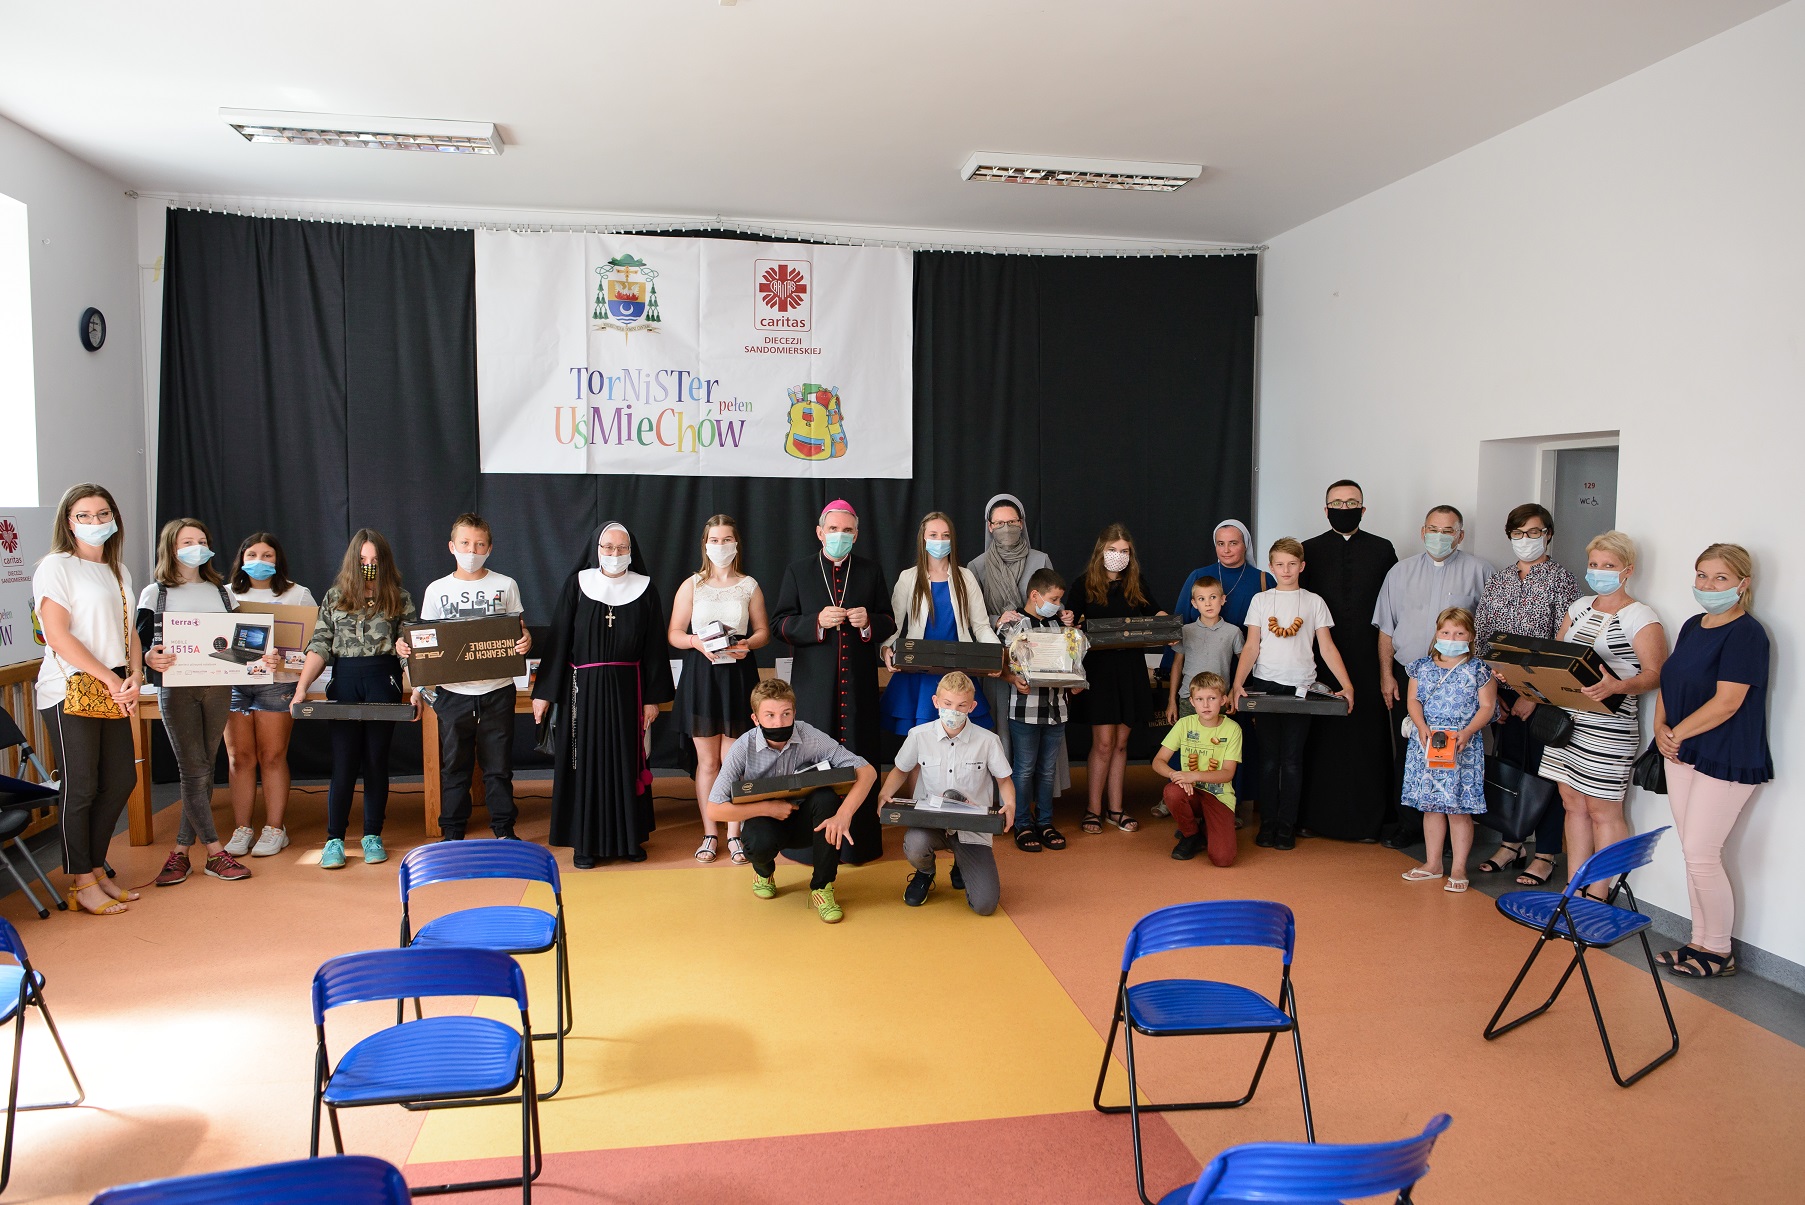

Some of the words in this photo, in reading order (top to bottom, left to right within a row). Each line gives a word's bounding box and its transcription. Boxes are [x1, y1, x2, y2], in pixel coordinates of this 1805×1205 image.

[760, 315, 806, 328] caritas
[764, 336, 802, 345] DIECEZJI
[744, 346, 822, 355] SANDOMIERSKIEJ
[719, 397, 753, 415] pełen
[1579, 497, 1590, 505] WC
[3, 556, 23, 565] caritas
[170, 645, 200, 654] 1515A
[469, 639, 515, 651] INCREDIBLE
[415, 651, 445, 660] ASUS
[464, 652, 475, 661] OF
[476, 648, 507, 660] SEARCH
[508, 648, 517, 657] IN
[1184, 747, 1208, 757] MIAMI
